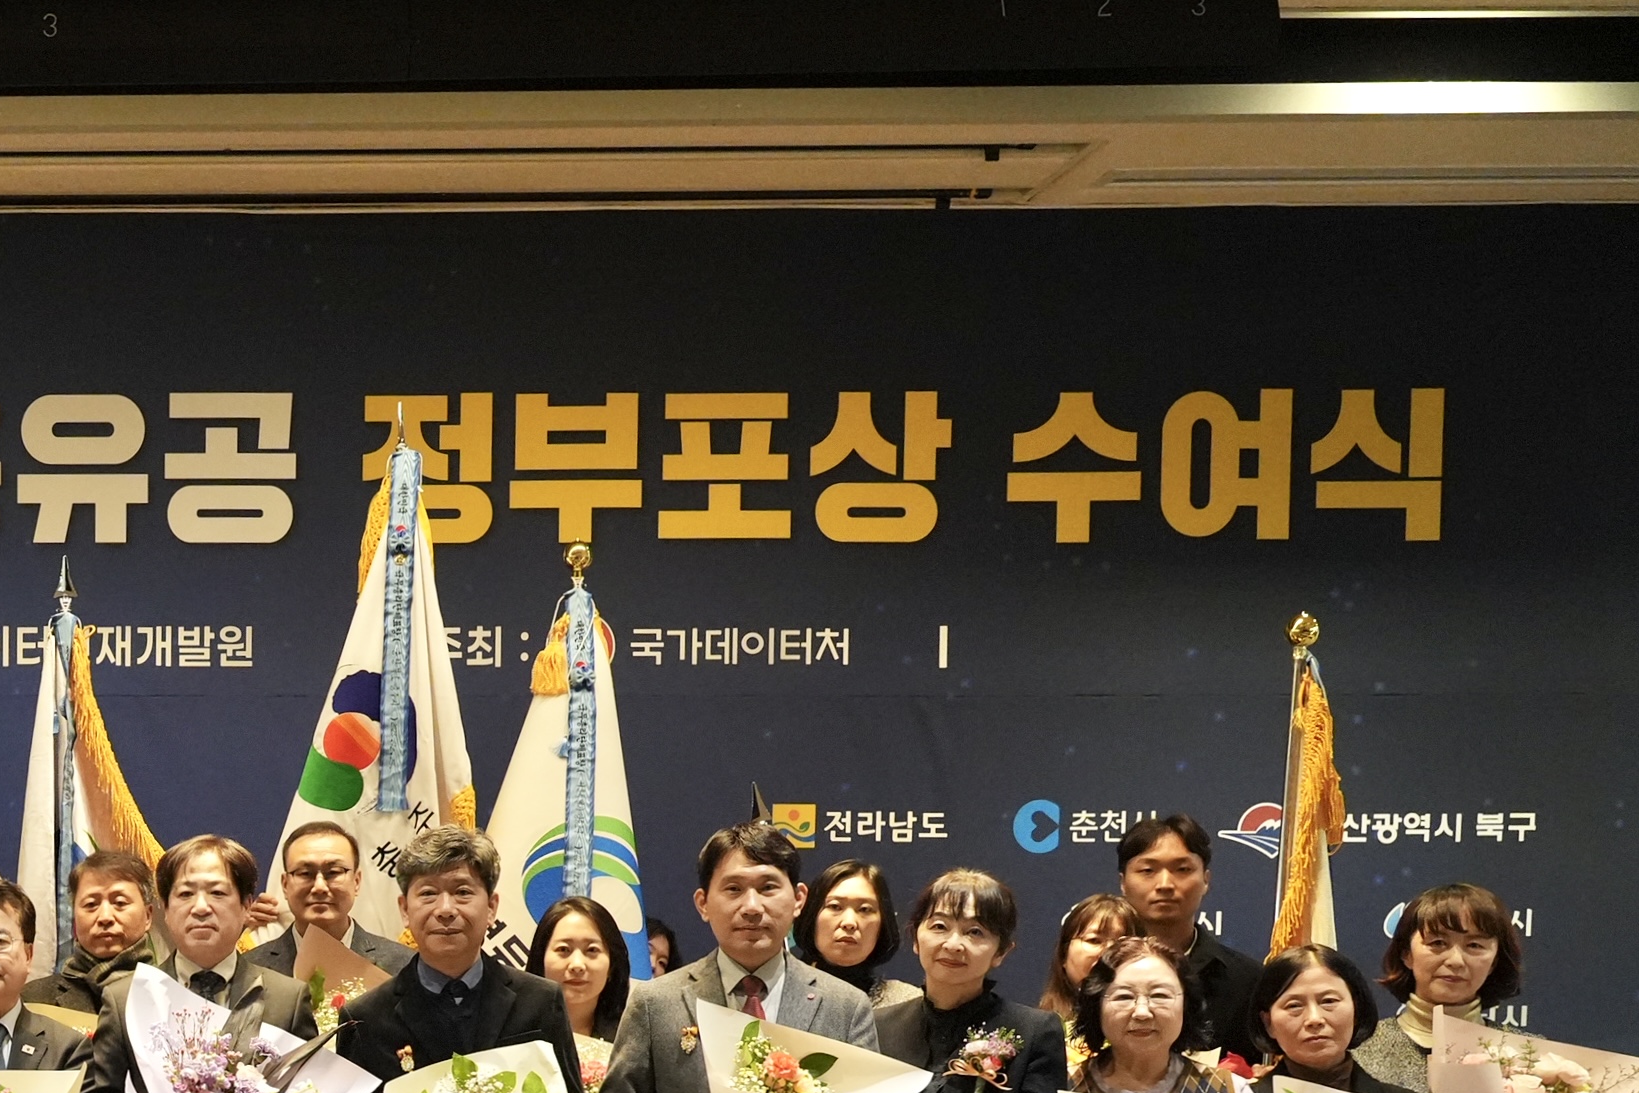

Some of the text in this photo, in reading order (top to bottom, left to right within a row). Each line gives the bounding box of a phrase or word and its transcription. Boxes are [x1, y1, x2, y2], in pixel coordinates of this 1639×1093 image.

[42, 13, 58, 38] 3
[361, 391, 952, 544] 정부포상
[1006, 387, 1446, 544] 수여식
[630, 627, 850, 666] 국가데이터처
[823, 810, 948, 843] 전라남도
[1342, 812, 1537, 845] 산광역시 북구
